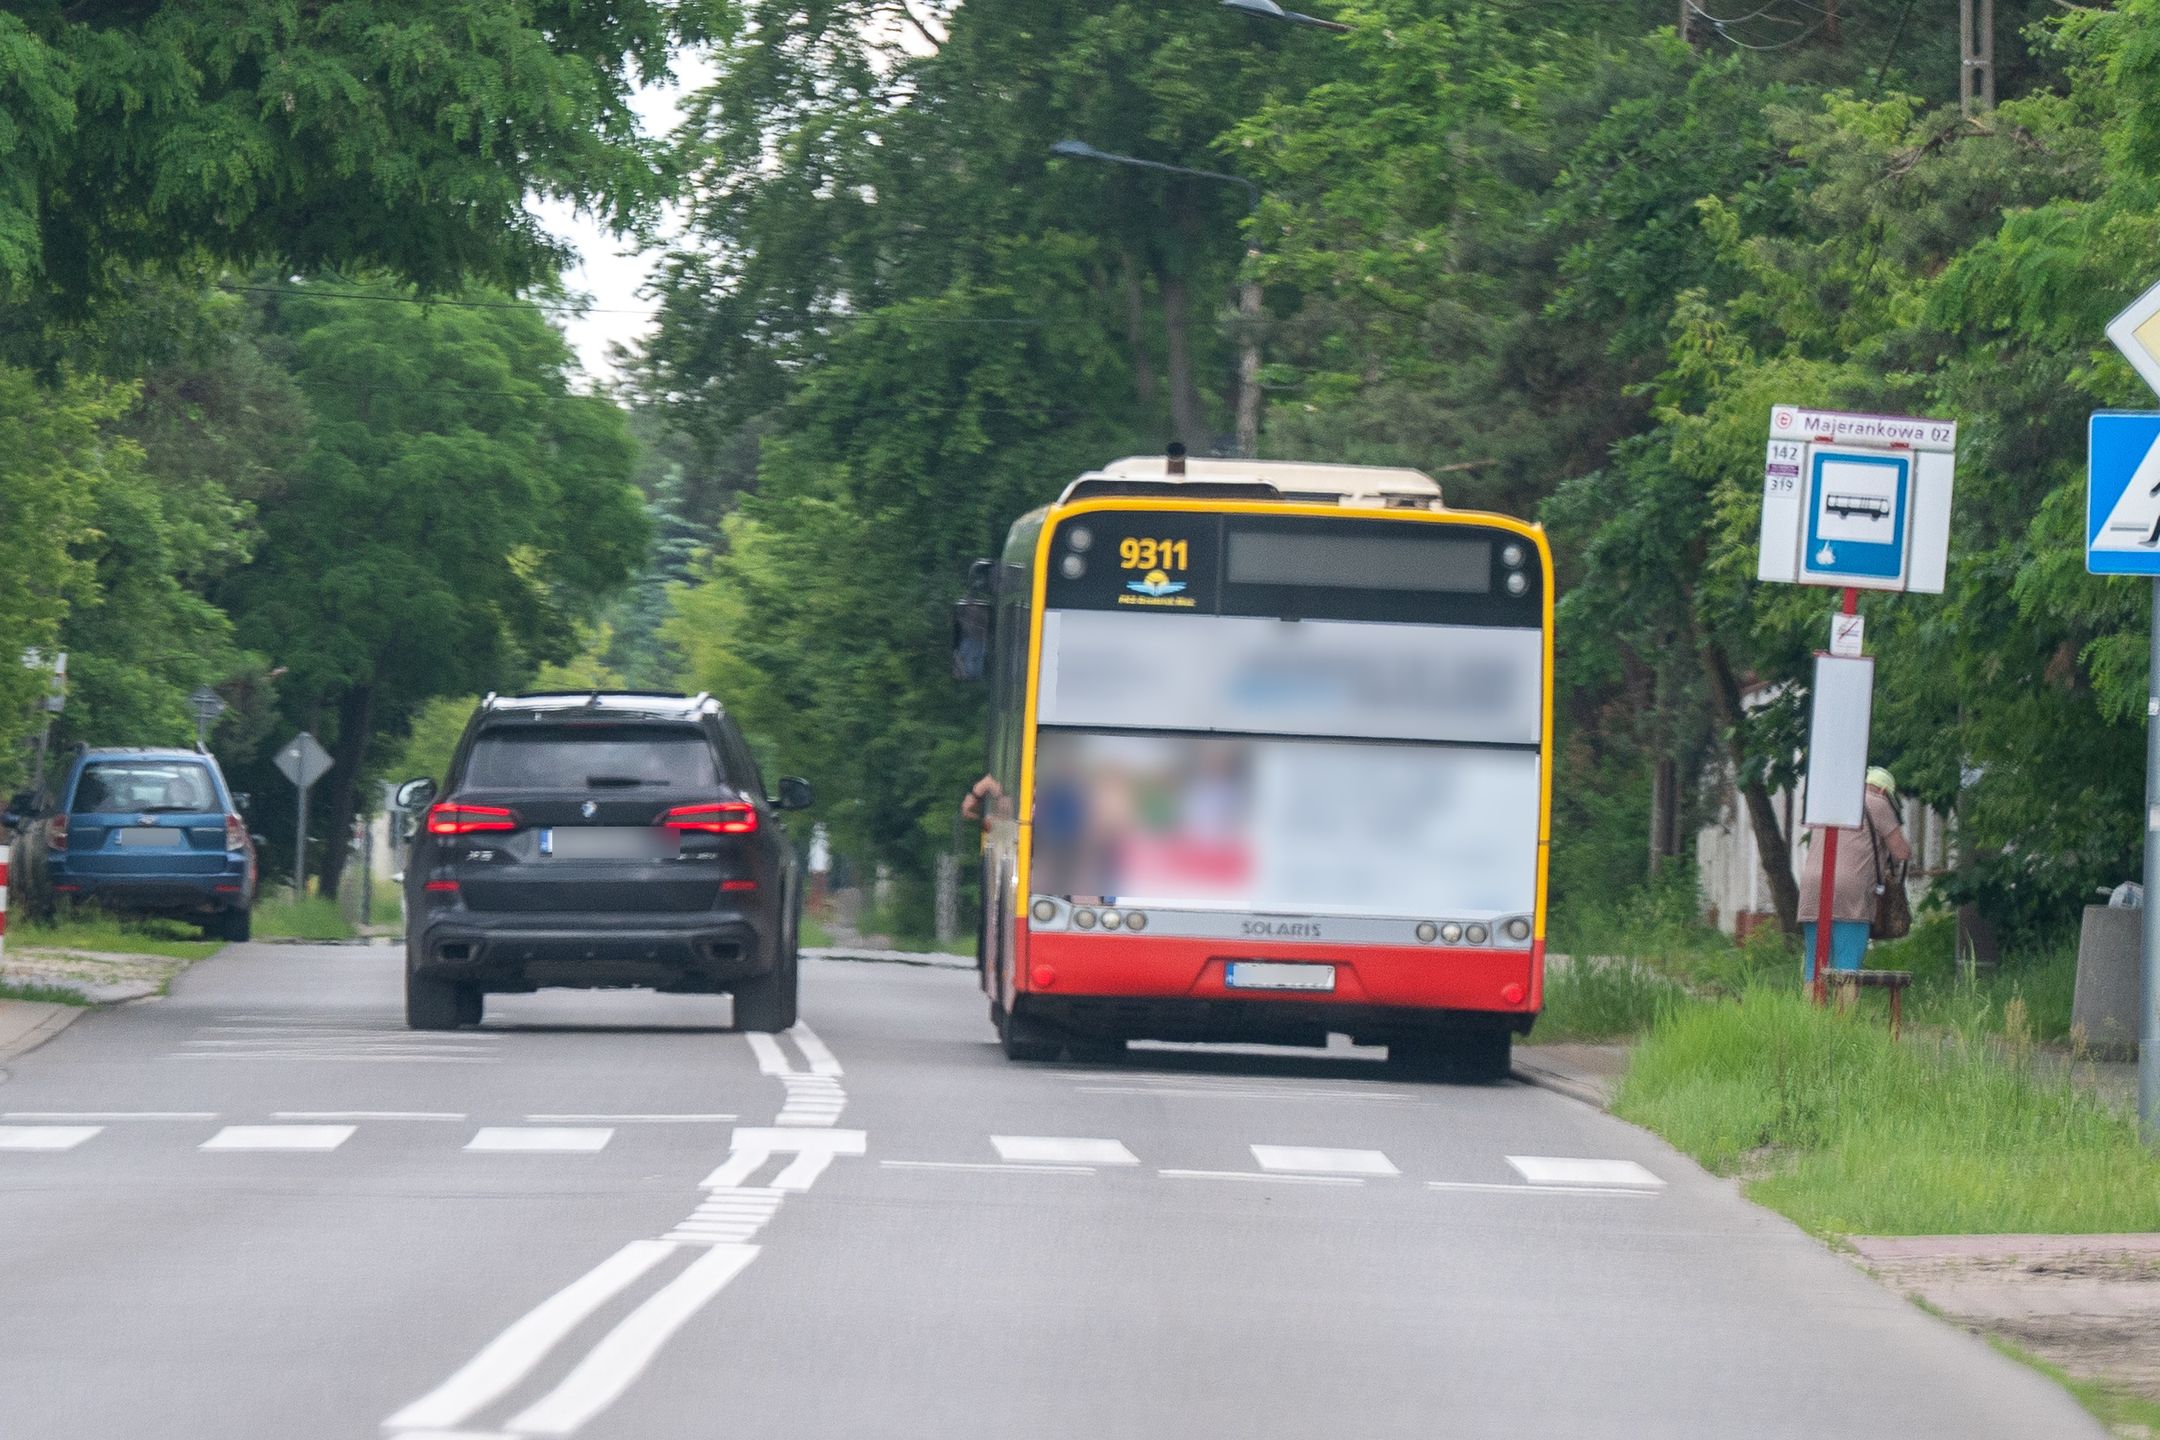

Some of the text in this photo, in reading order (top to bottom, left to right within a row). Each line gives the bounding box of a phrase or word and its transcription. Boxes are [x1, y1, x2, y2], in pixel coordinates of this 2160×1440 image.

[1804, 416, 1950, 443] Majerankowa 02
[1772, 446, 1798, 461] 142
[1770, 479, 1794, 492] 319
[1119, 536, 1189, 571] 9311
[1242, 920, 1322, 937] SOLARIS
